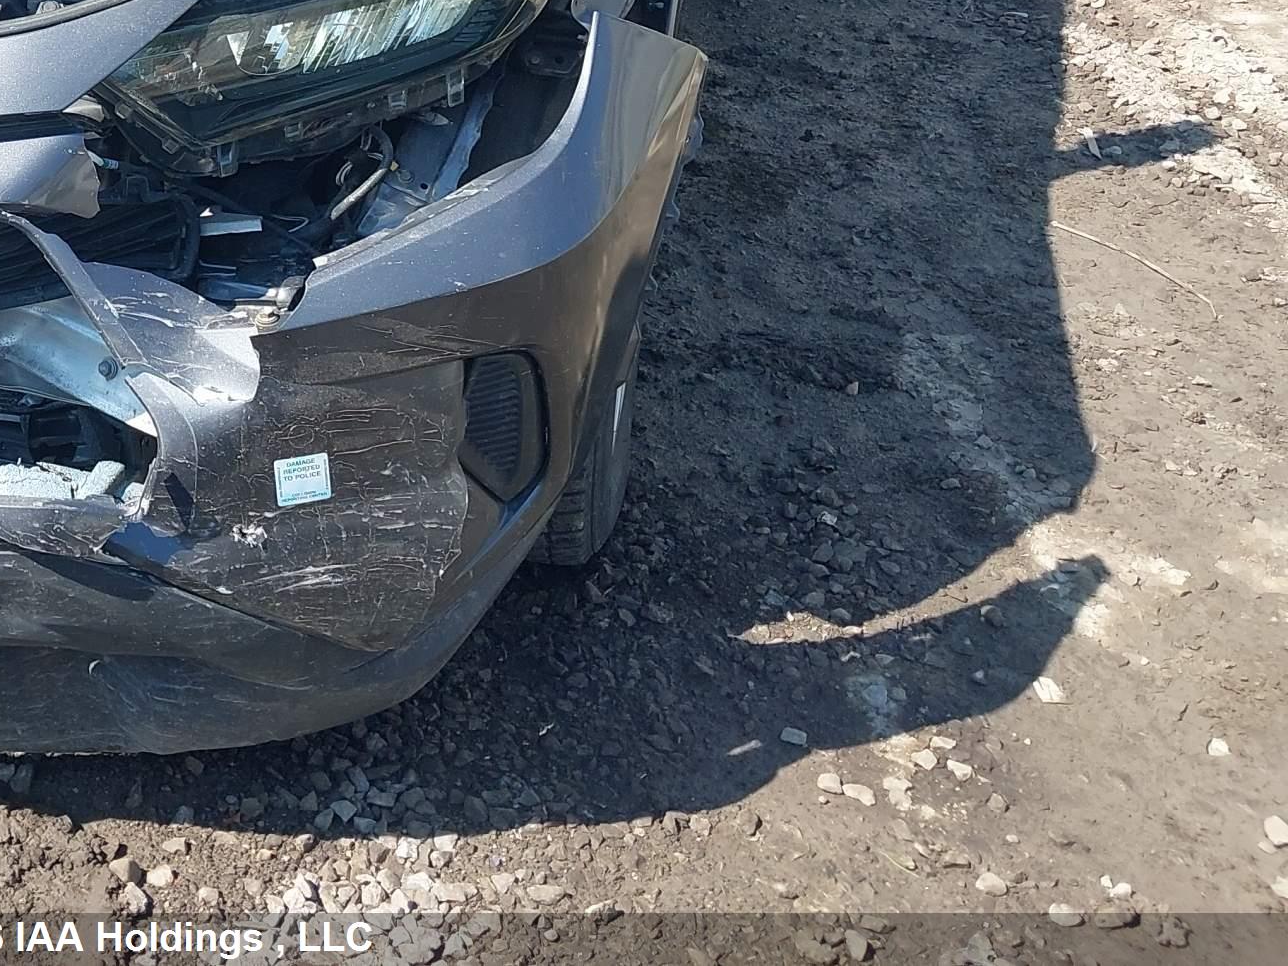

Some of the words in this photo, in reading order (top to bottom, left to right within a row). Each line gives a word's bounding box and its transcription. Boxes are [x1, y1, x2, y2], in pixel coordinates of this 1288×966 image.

[286, 458, 316, 467] DAMAGE
[283, 464, 320, 474] REPORTED
[295, 471, 321, 480] POLICE
